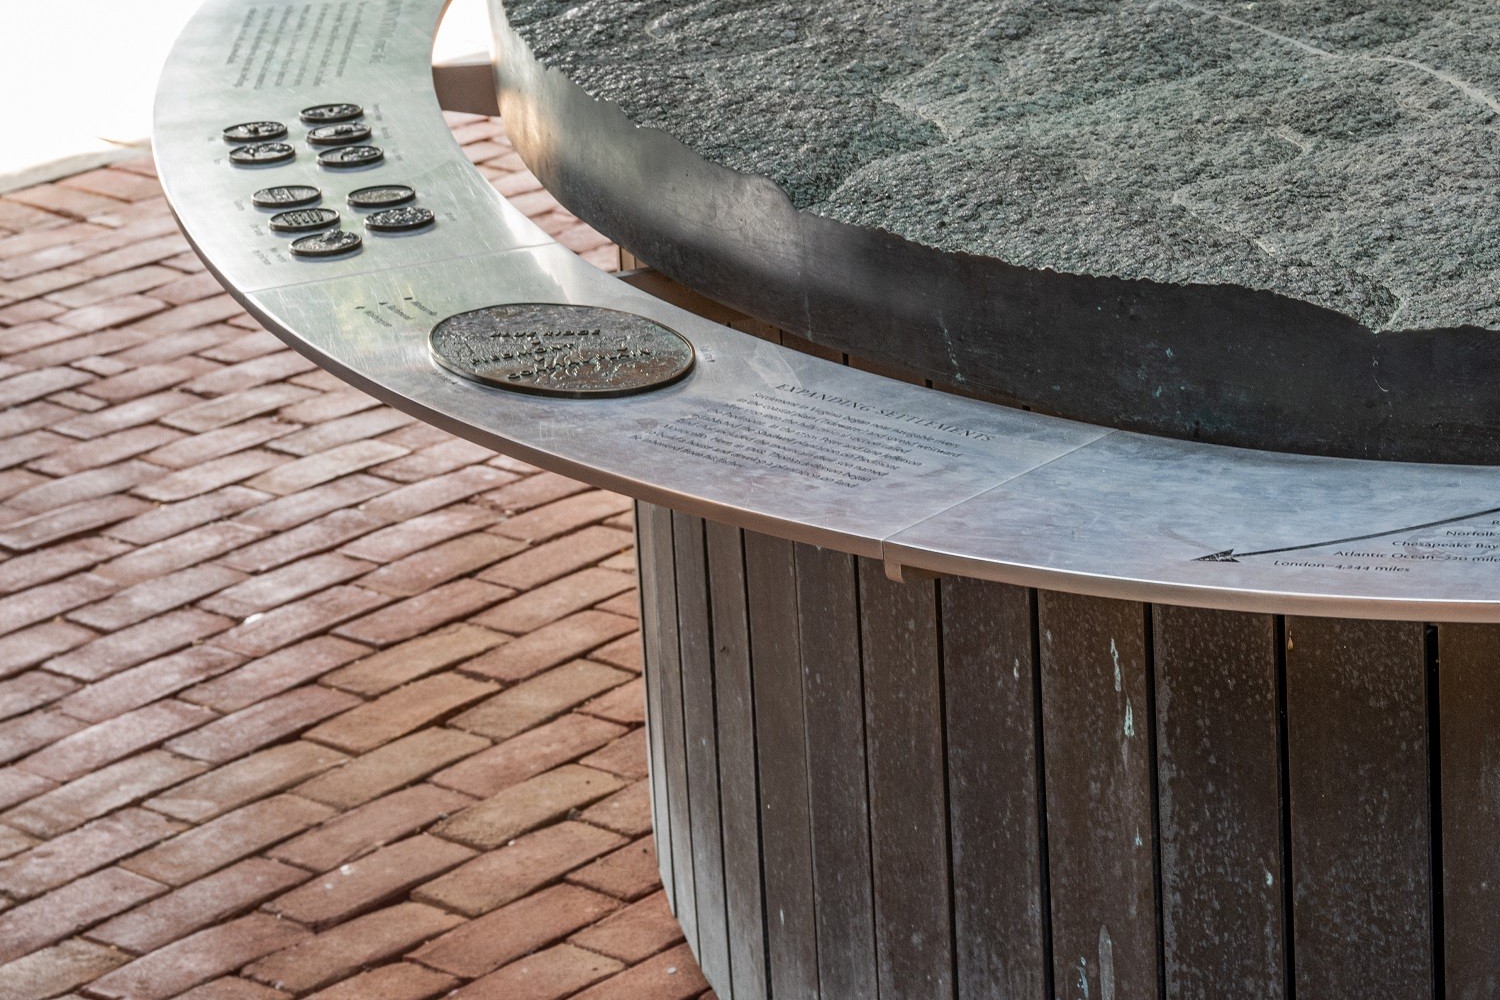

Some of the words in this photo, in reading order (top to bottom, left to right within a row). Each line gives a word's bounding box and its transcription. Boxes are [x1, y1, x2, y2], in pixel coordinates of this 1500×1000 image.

[776, 384, 875, 411] EXPANDING
[876, 410, 996, 441] SETTLEMENTS
[1392, 541, 1470, 549] Chesapeake
[1374, 565, 1410, 573] miles
